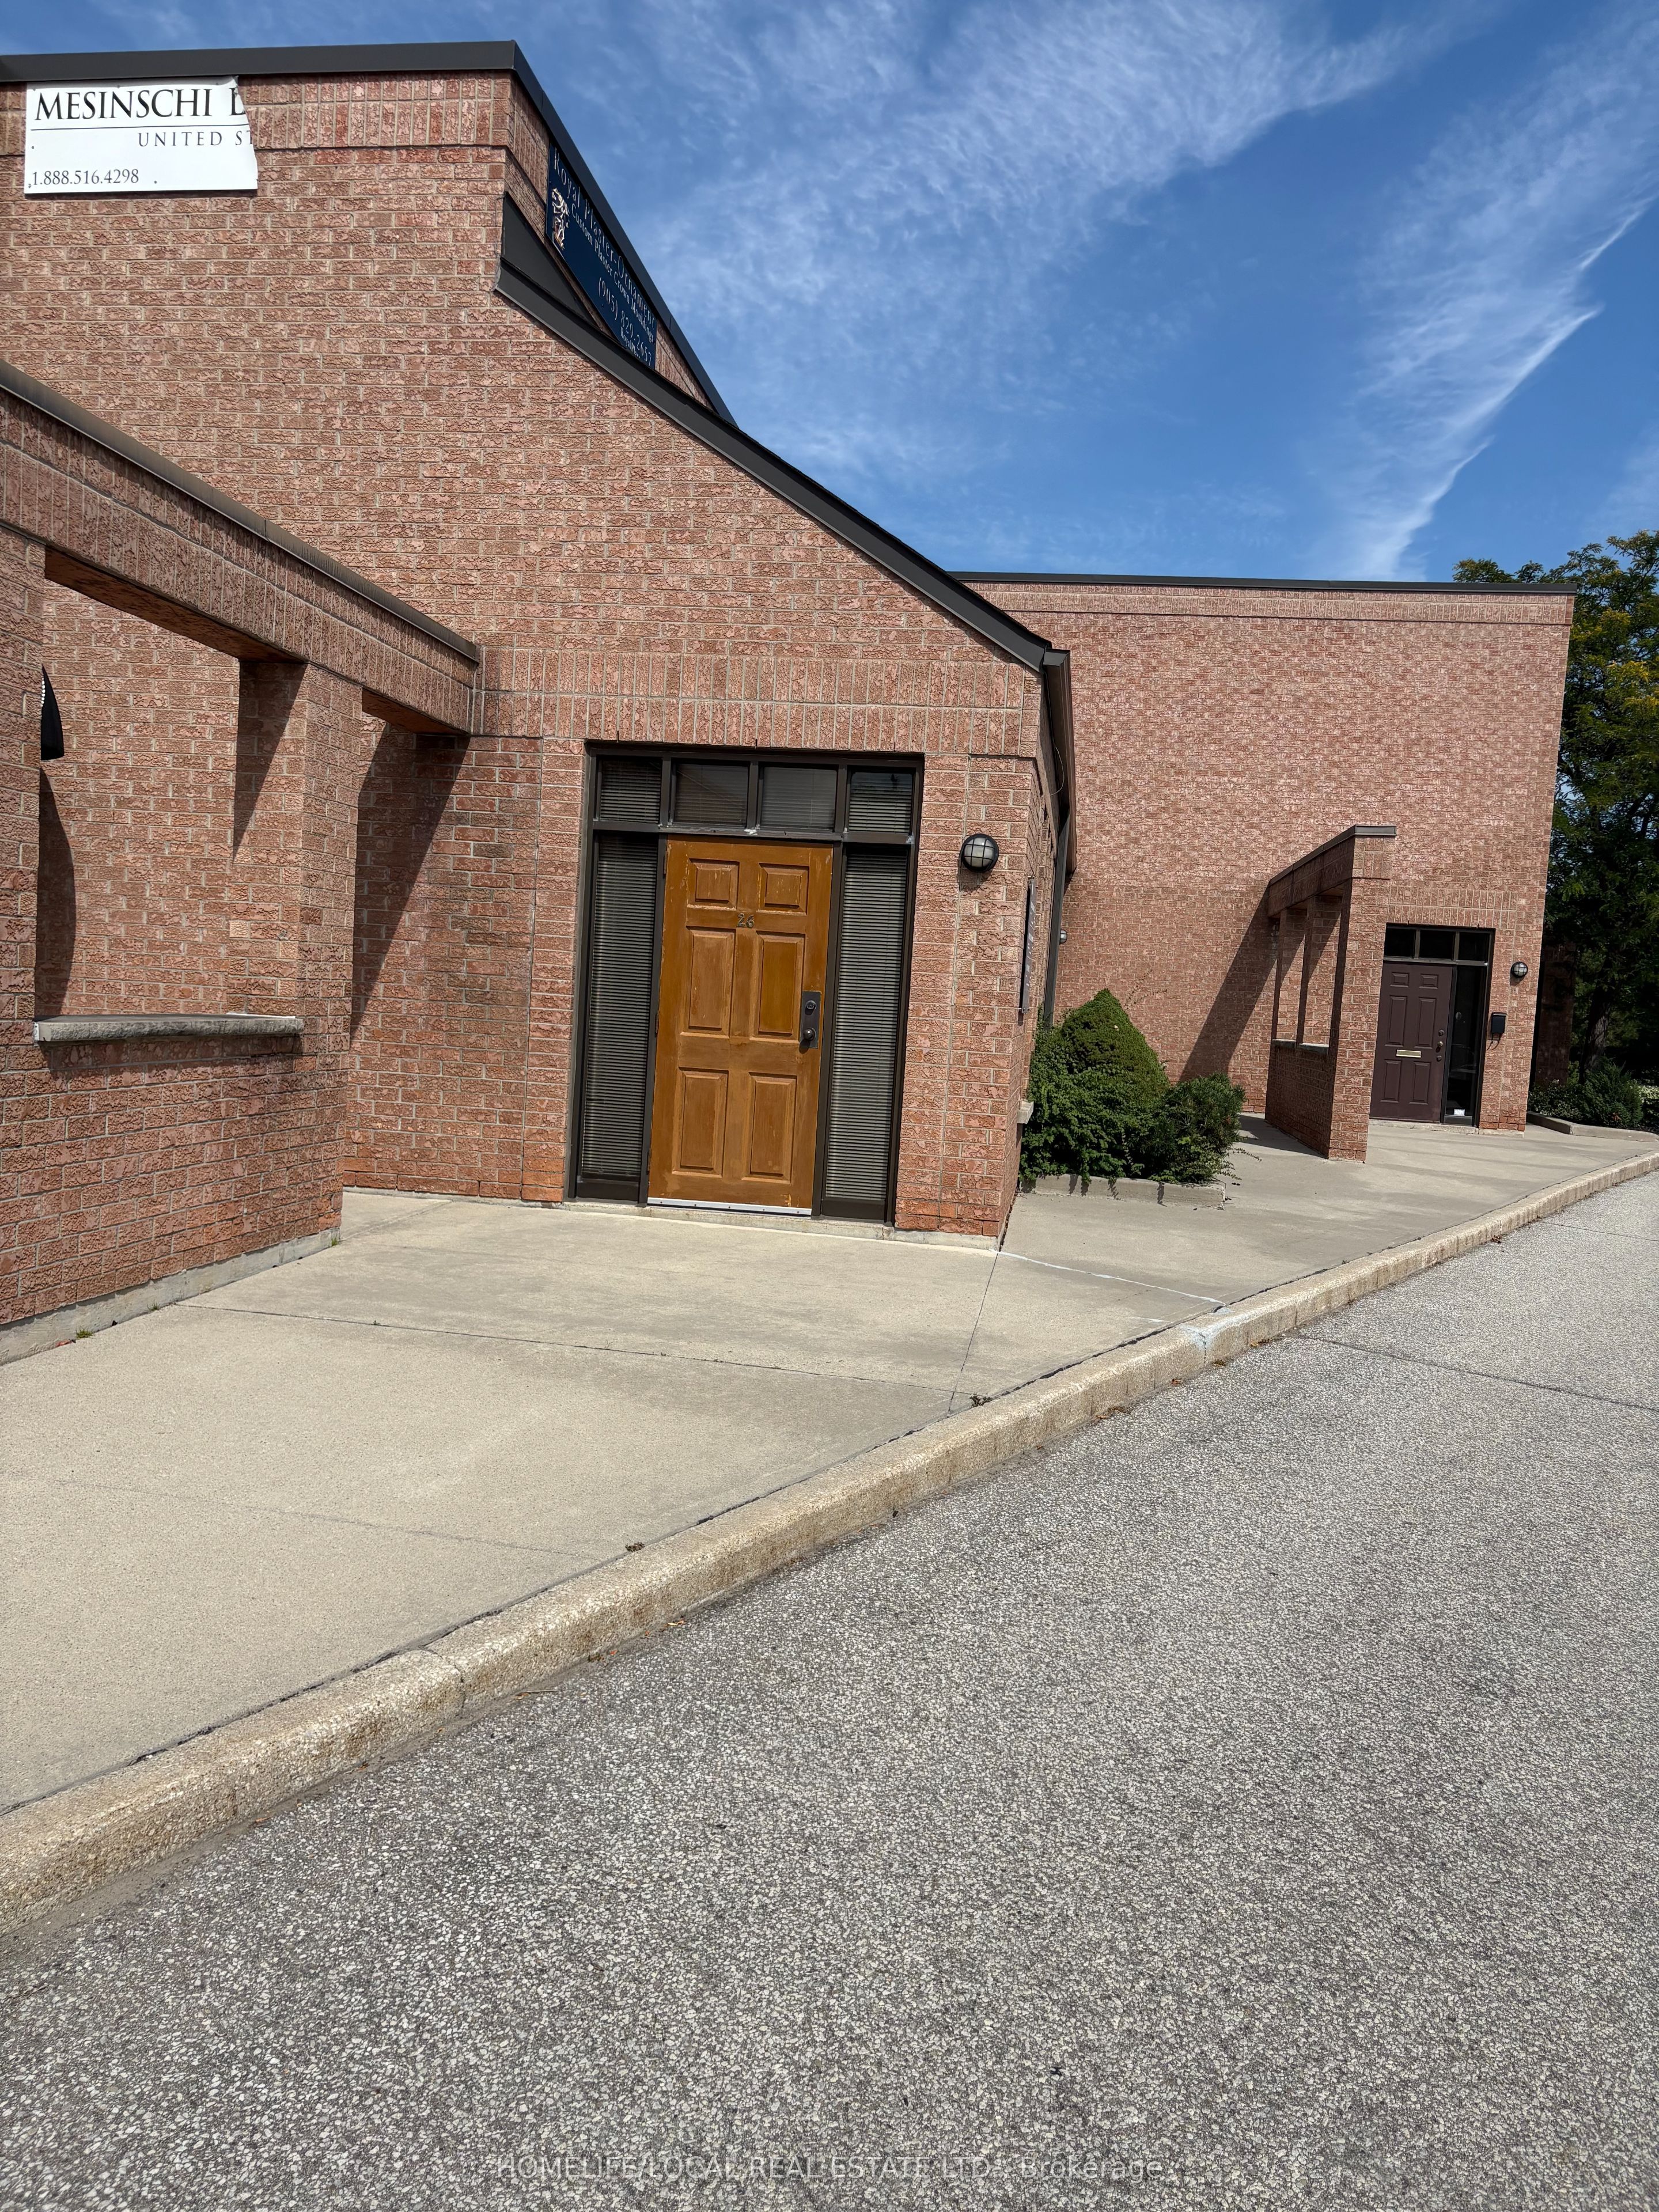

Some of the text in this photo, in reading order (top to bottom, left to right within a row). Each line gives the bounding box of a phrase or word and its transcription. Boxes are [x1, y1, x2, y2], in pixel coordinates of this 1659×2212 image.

[35, 88, 213, 121] MESINSCHI
[138, 131, 223, 147] UNITED
[32, 168, 139, 185] 1.888.516.4298
[554, 147, 581, 208] Royal
[571, 203, 654, 343] Custom Plaster Crown Mouldings
[599, 276, 652, 366] (905) 829-2657
[737, 912, 755, 929] 26
